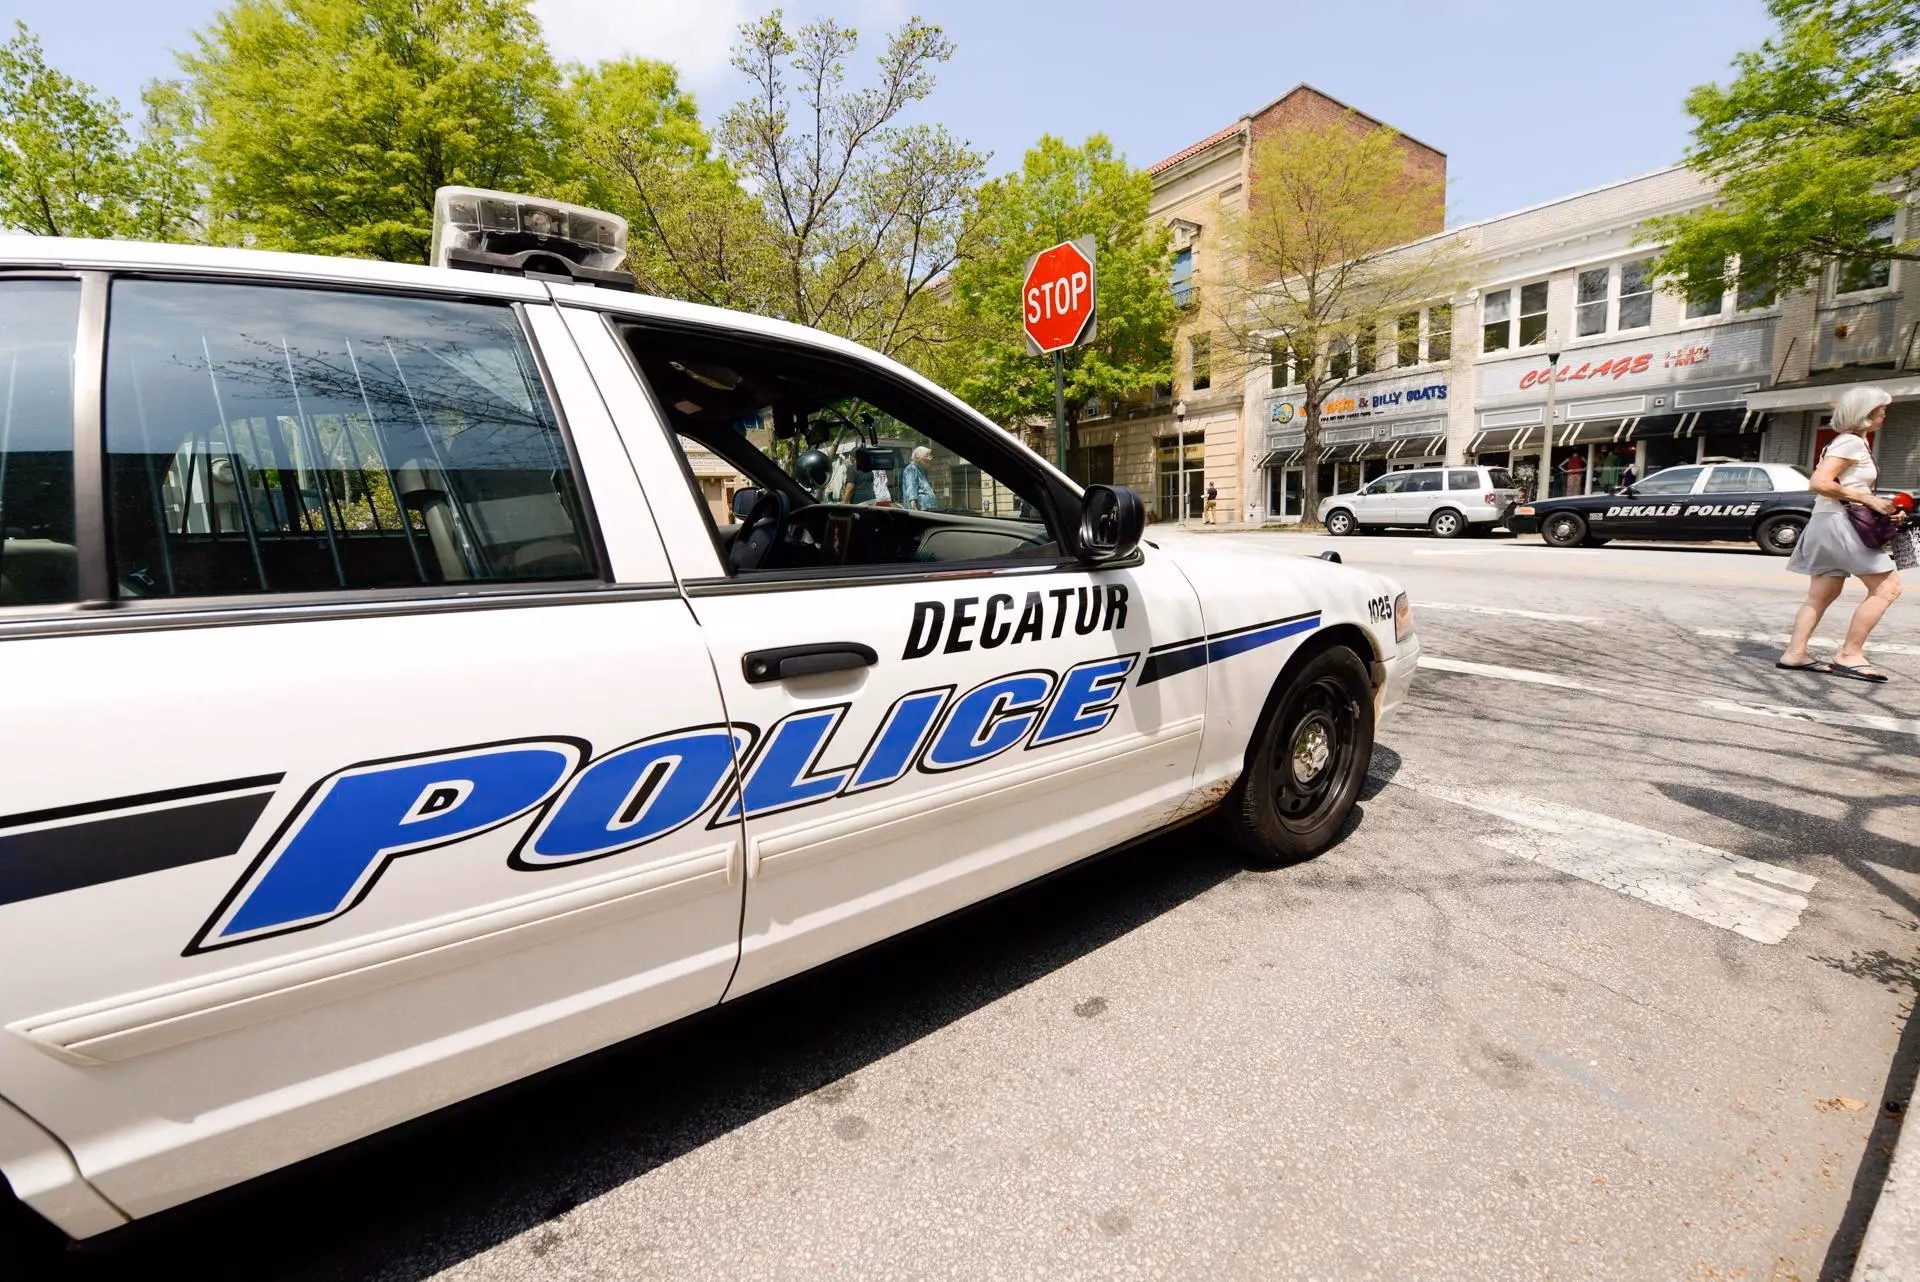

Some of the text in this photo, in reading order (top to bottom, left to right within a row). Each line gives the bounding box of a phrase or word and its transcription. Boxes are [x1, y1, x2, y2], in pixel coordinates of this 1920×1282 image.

[1027, 271, 1087, 324] STOP
[1519, 352, 1653, 390] COLLAGE
[1358, 397, 1369, 409] &
[1372, 391, 1403, 408] BILLY
[1406, 384, 1448, 402] GOATS
[1606, 505, 1681, 517] DEKALB
[1684, 504, 1761, 517] POLICE
[901, 583, 1129, 660] DECATUR
[1368, 595, 1392, 624] 1025
[180, 652, 1140, 957] POLICE
